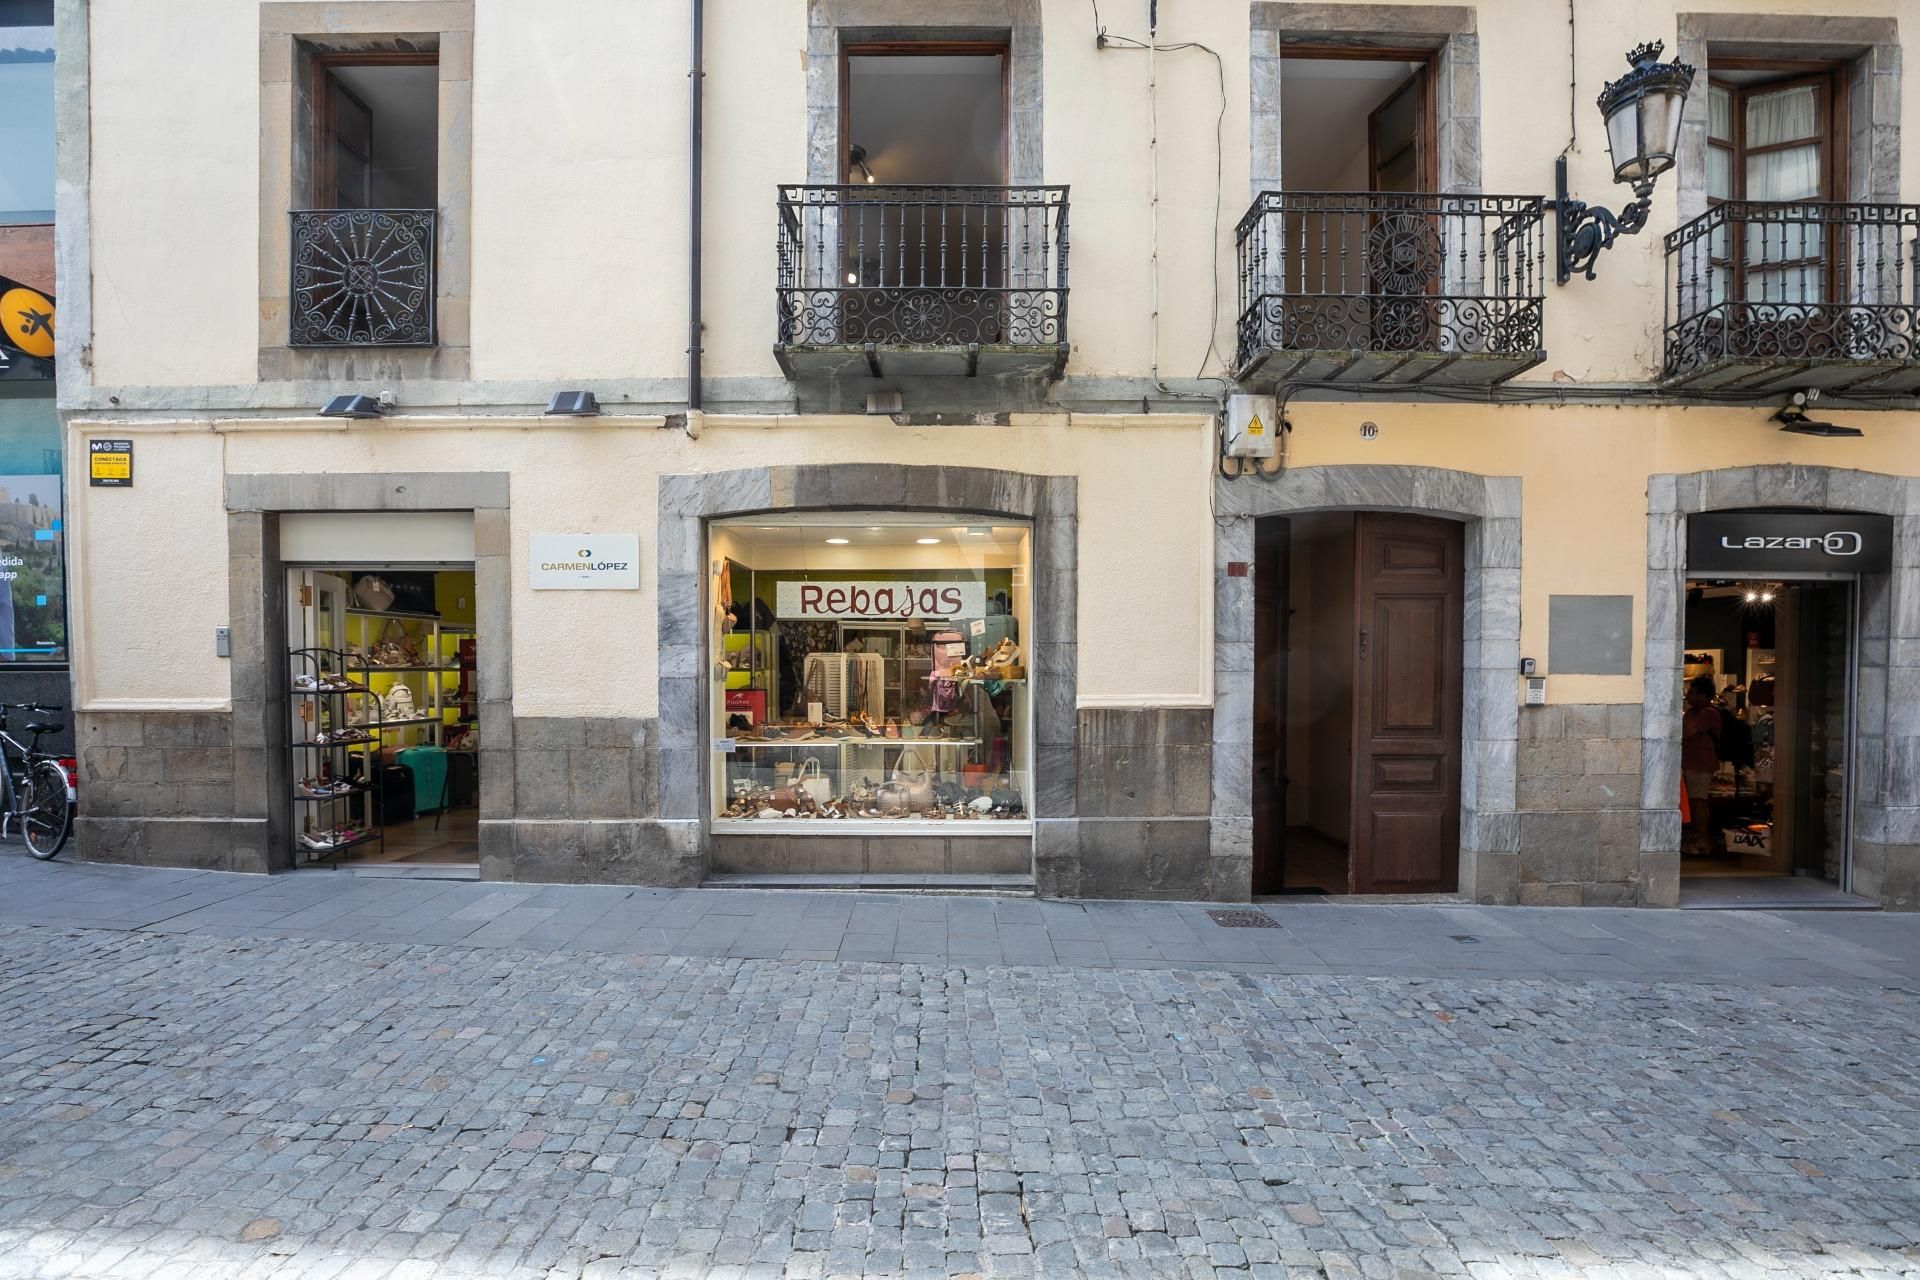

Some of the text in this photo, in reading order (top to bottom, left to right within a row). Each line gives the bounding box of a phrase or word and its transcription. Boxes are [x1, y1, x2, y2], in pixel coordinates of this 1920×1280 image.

[1362, 425, 1375, 437] 10
[0, 556, 24, 566] dida
[541, 561, 628, 571] CARMENLÓPEZ
[801, 585, 963, 617] Rebajas
